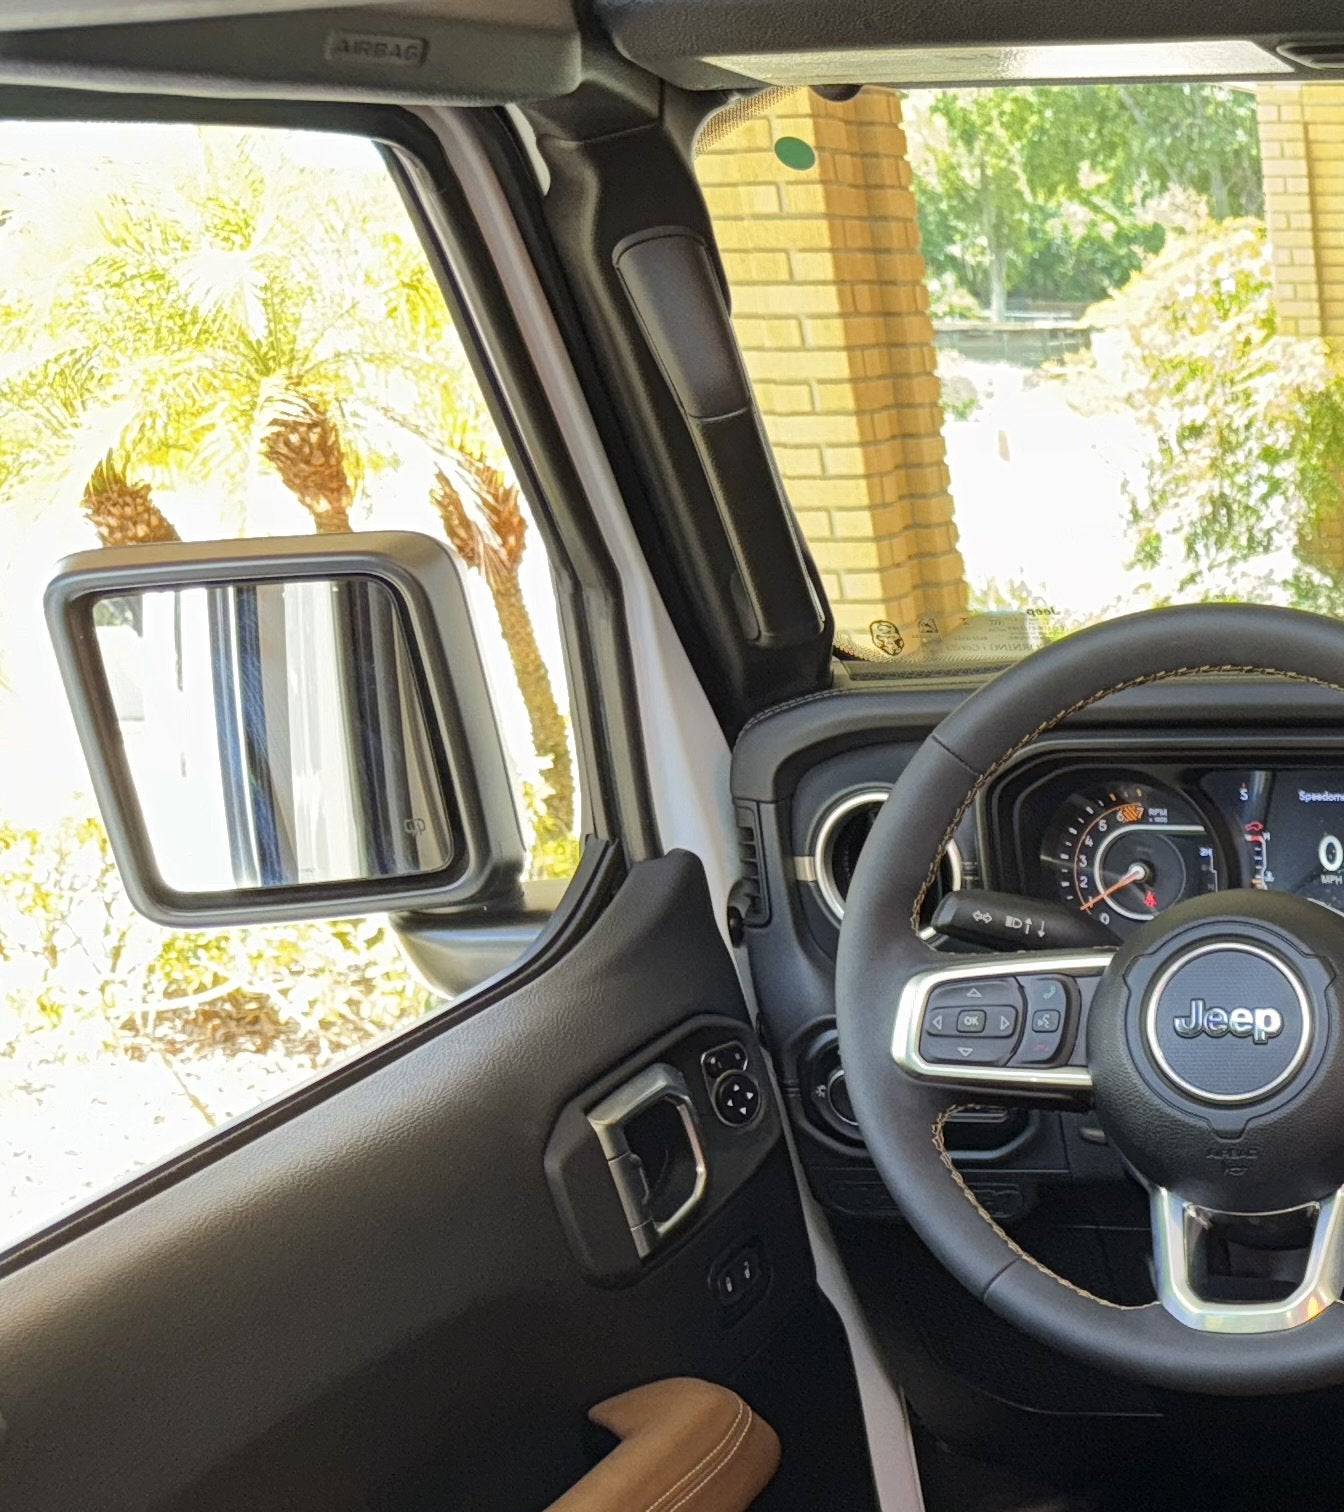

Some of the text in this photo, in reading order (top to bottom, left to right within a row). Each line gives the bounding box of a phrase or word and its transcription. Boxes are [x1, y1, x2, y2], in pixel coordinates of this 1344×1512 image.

[334, 39, 419, 61] AIRBAG
[1148, 808, 1168, 817] RPM
[1098, 819, 1107, 831] 5
[1084, 835, 1093, 847] 4
[1318, 834, 1344, 872] 0
[1079, 855, 1088, 867] 3
[1080, 876, 1088, 888] 2
[1320, 875, 1343, 885] MPH
[1100, 913, 1110, 925] 0
[964, 1015, 979, 1026] OK
[1173, 998, 1284, 1045] Jeep
